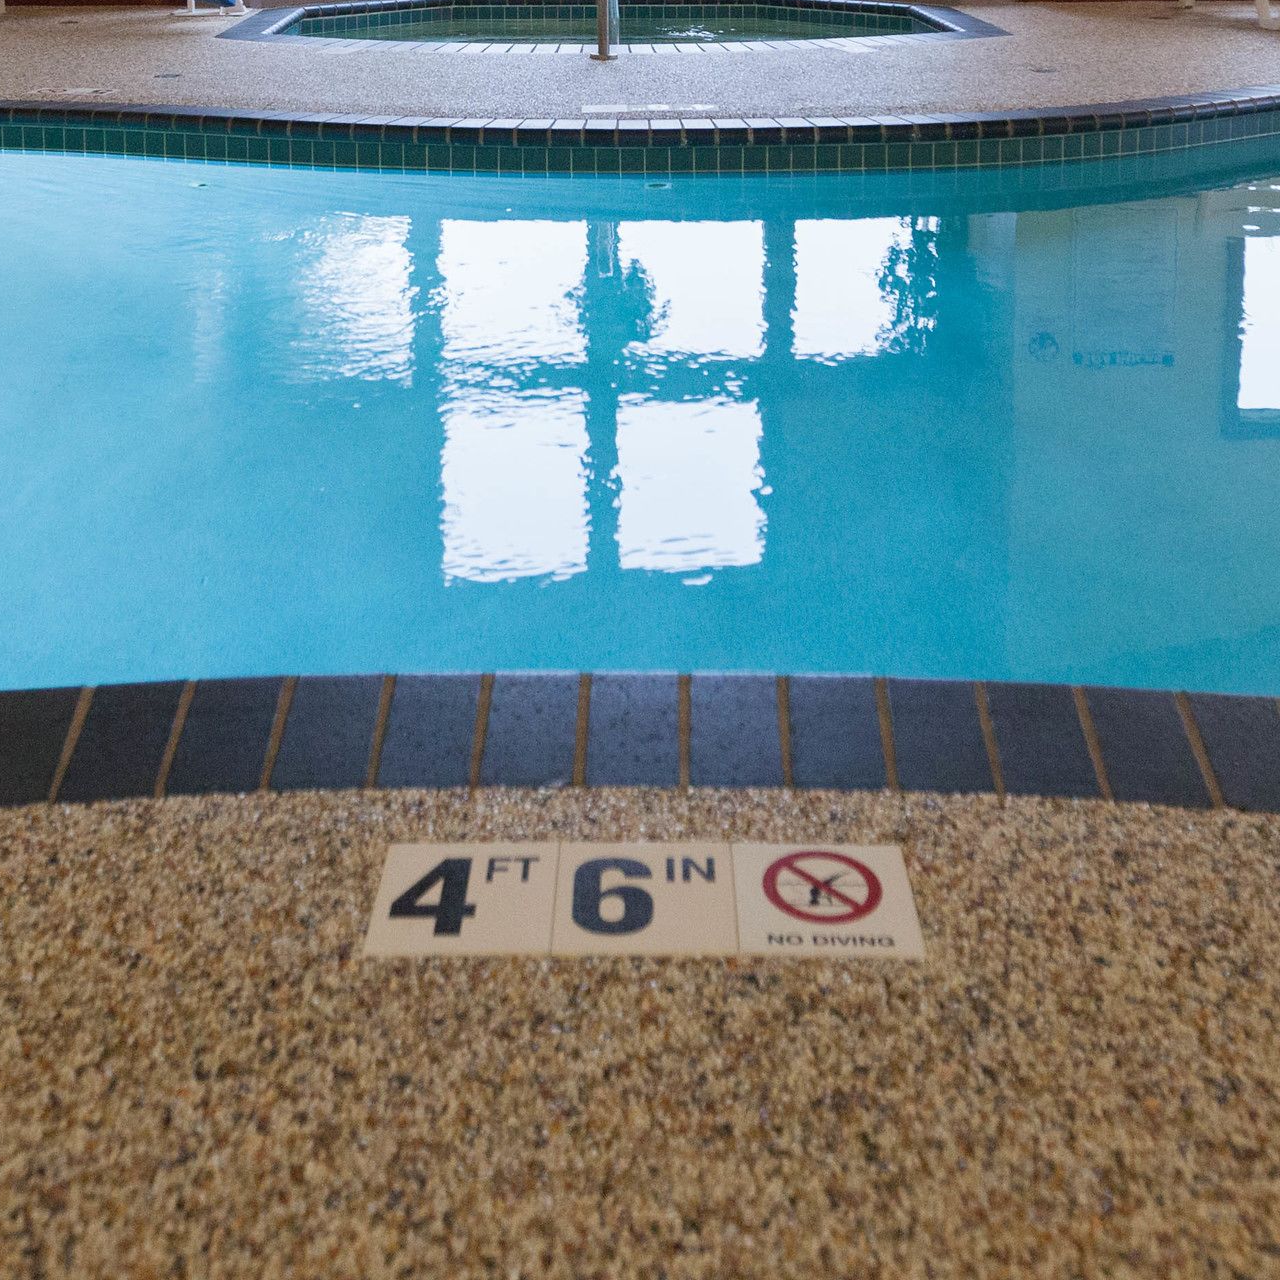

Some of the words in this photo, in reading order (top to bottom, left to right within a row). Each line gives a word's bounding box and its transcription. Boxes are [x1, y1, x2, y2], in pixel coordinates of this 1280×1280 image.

[388, 857, 477, 937] 4
[486, 856, 540, 883] FT
[571, 857, 655, 936] 6
[665, 856, 717, 884] IN
[767, 933, 804, 946] NO
[812, 933, 896, 948] DIVING
